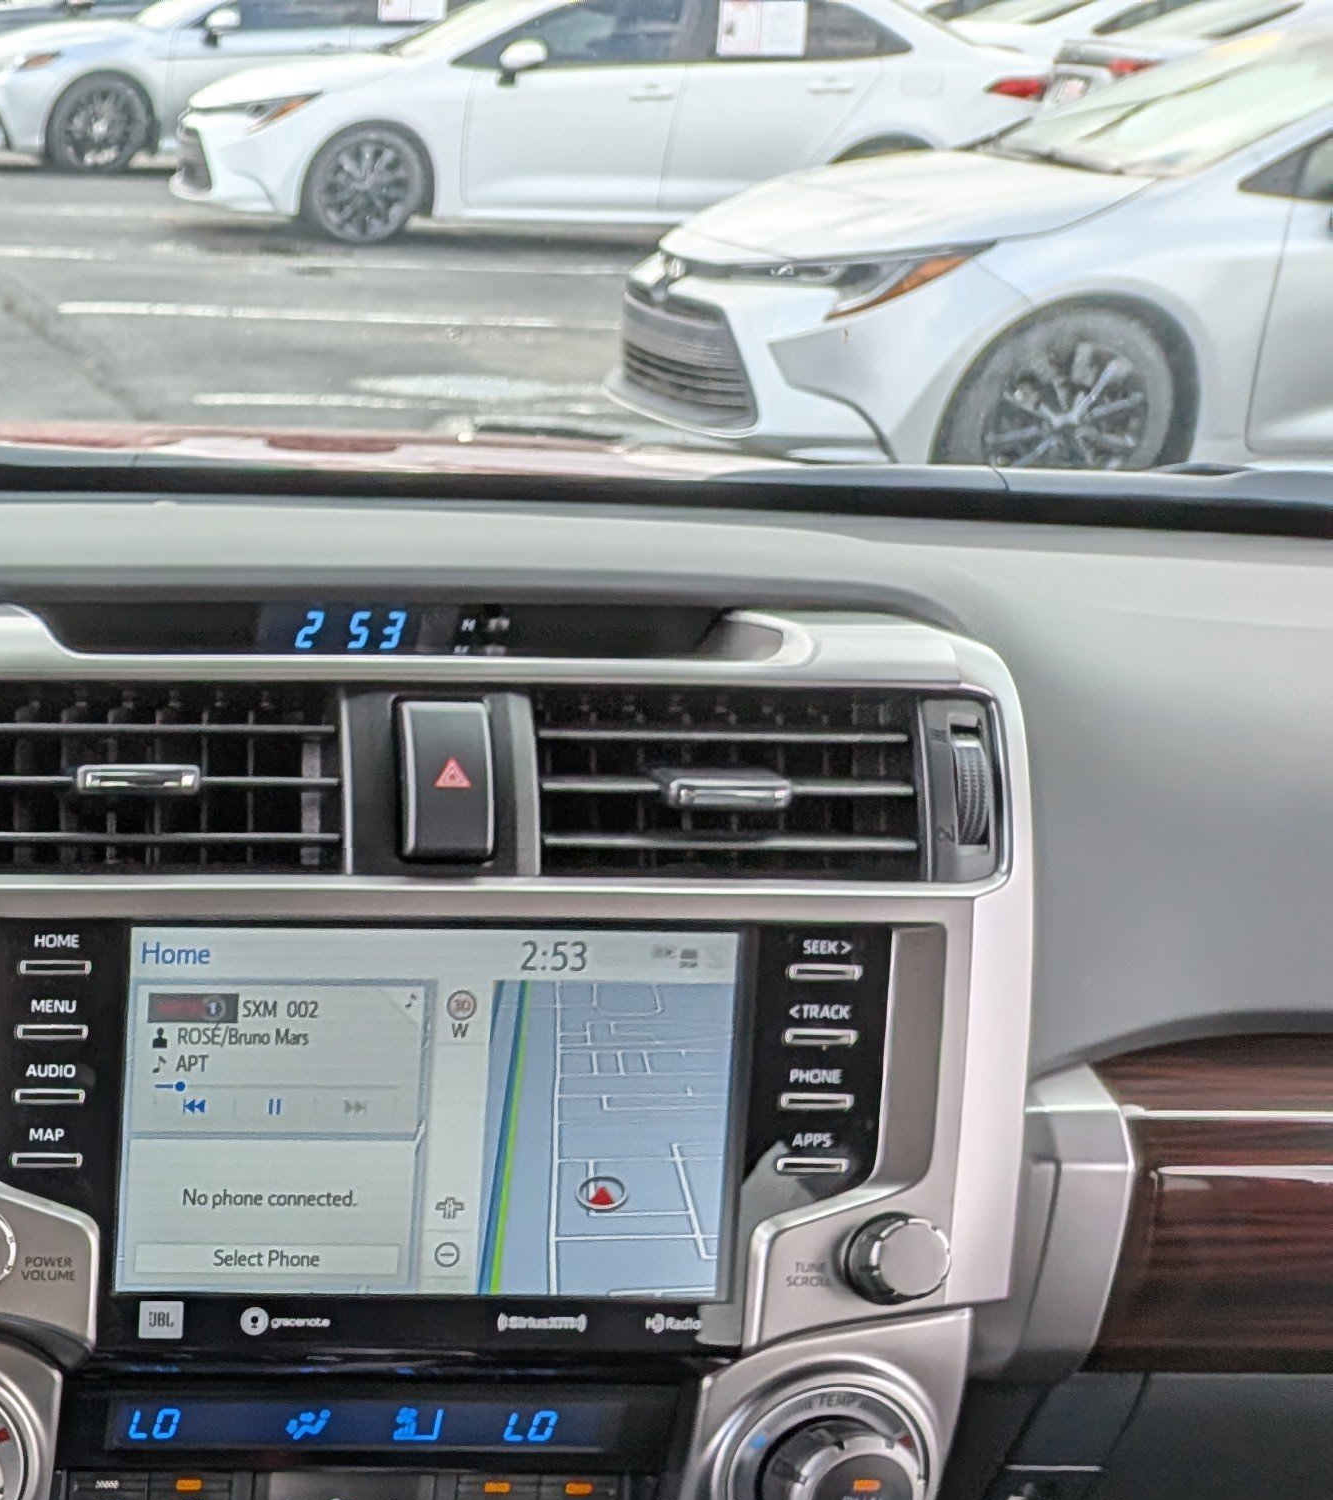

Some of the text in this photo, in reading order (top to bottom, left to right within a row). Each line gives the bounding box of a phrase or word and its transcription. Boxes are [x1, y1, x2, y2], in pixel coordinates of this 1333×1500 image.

[33, 934, 80, 949] HOME
[141, 941, 211, 966] Home
[521, 940, 588, 972] 2:53
[30, 999, 78, 1014] MENU
[241, 1000, 319, 1019] SXM 002
[802, 1003, 852, 1020] TRACK
[177, 1023, 309, 1047] ROSÉ/Bruno Mars
[451, 1022, 470, 1039] W
[25, 1063, 77, 1078] AUDIO
[175, 1054, 209, 1073] APT
[789, 1068, 843, 1084] PHONE
[29, 1127, 65, 1142] MAP
[791, 1132, 834, 1148] APPS
[182, 1188, 359, 1211] No phone connected.
[24, 1255, 73, 1268] POWER
[213, 1249, 320, 1268] Select Phone
[795, 1261, 826, 1273] TUNE
[21, 1269, 76, 1282] VOLUME
[148, 1312, 175, 1328] JBL
[128, 1407, 183, 1441] LO
[503, 1409, 559, 1442] LO
